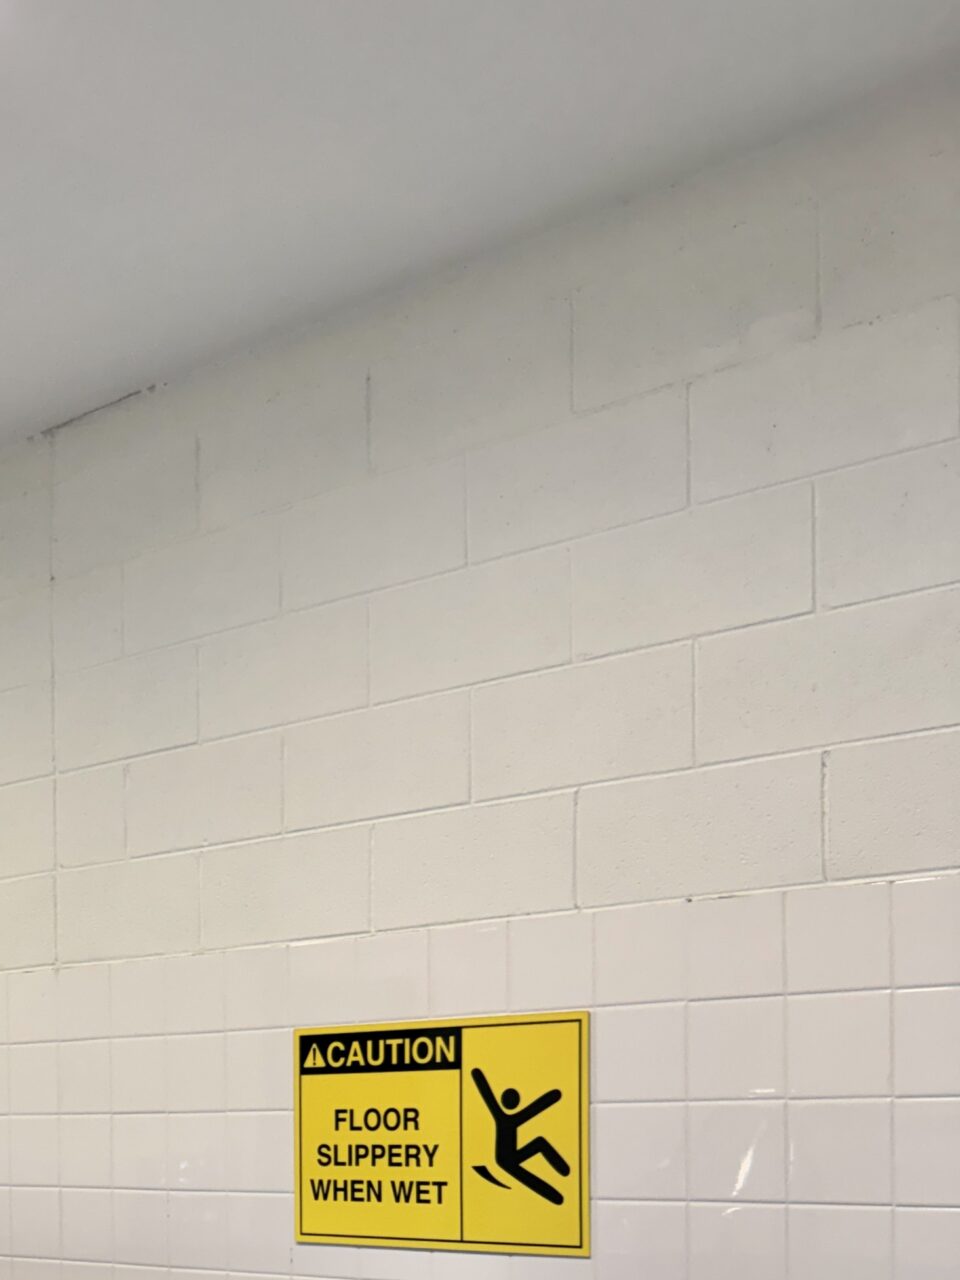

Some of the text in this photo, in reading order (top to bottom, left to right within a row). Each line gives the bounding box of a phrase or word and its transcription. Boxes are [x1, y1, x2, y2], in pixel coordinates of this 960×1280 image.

[326, 1036, 455, 1068] CAUTION
[334, 1107, 420, 1131] FLOOR
[316, 1144, 440, 1167] SLIPPERY
[310, 1179, 448, 1204] WHEN WET
